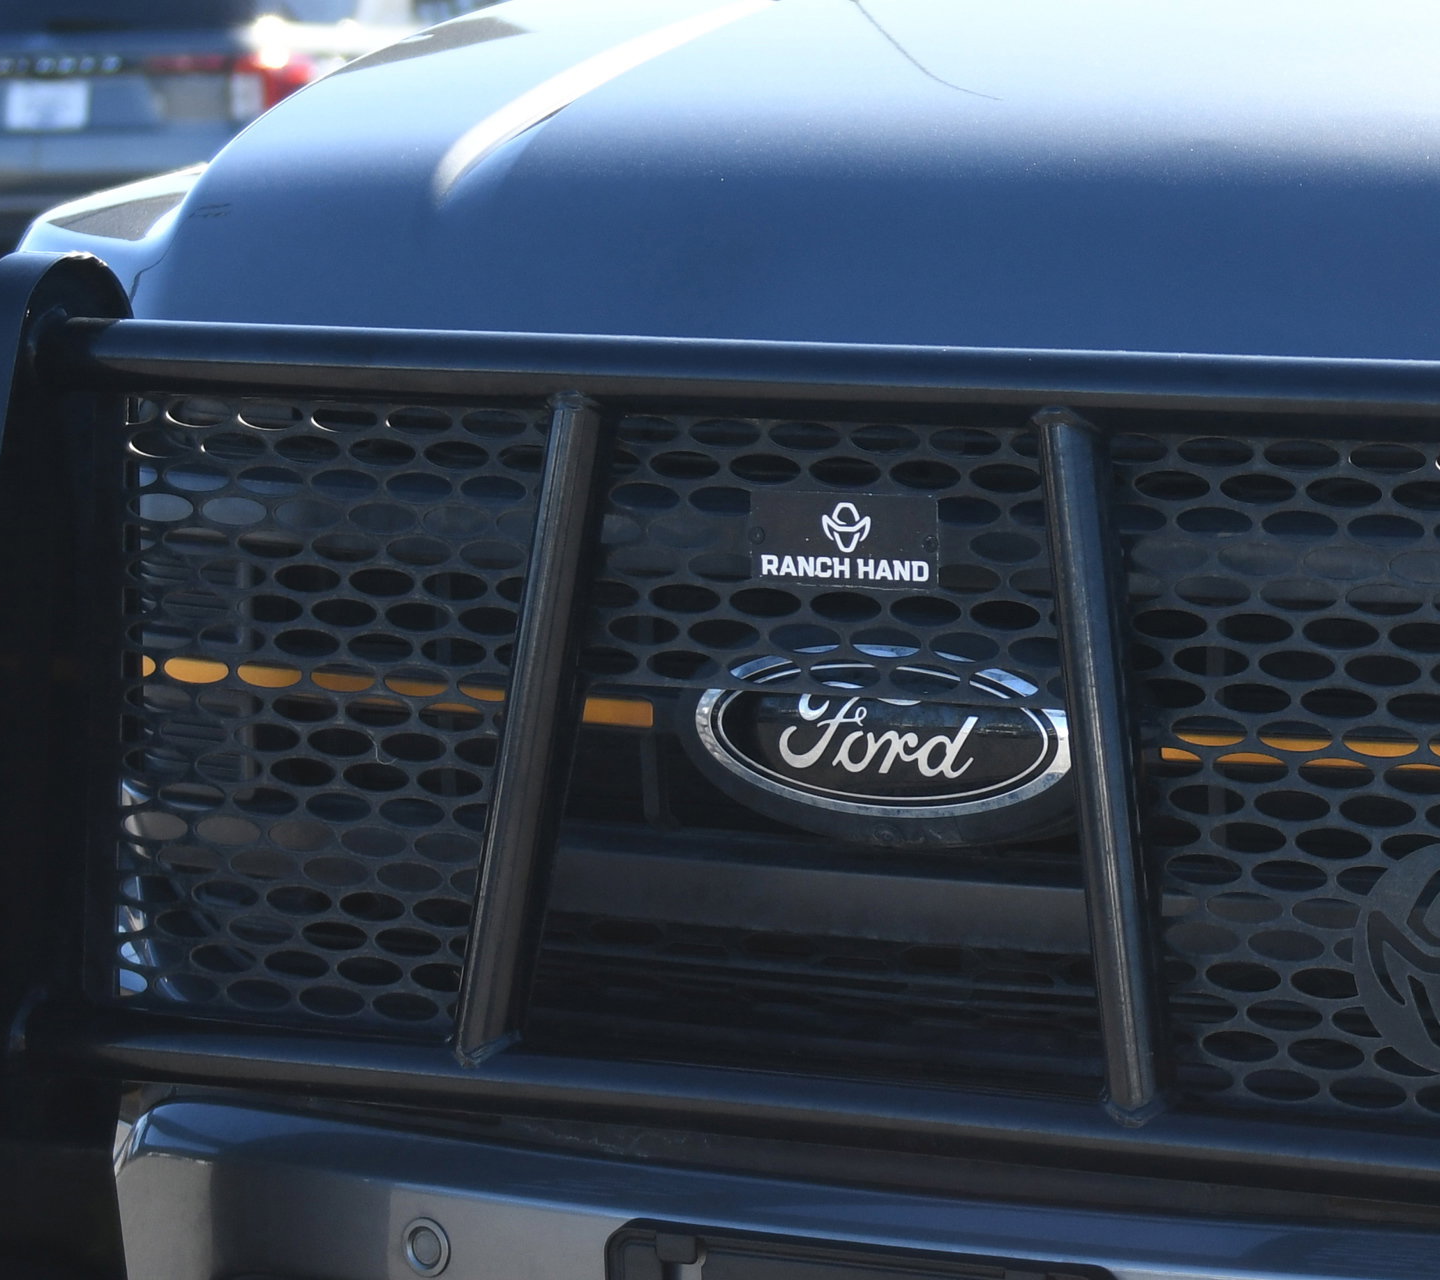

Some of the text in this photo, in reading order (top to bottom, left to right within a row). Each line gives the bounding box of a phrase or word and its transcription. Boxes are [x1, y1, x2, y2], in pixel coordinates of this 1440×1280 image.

[761, 554, 930, 582] RANCH HAND
[779, 693, 979, 779] Ford
